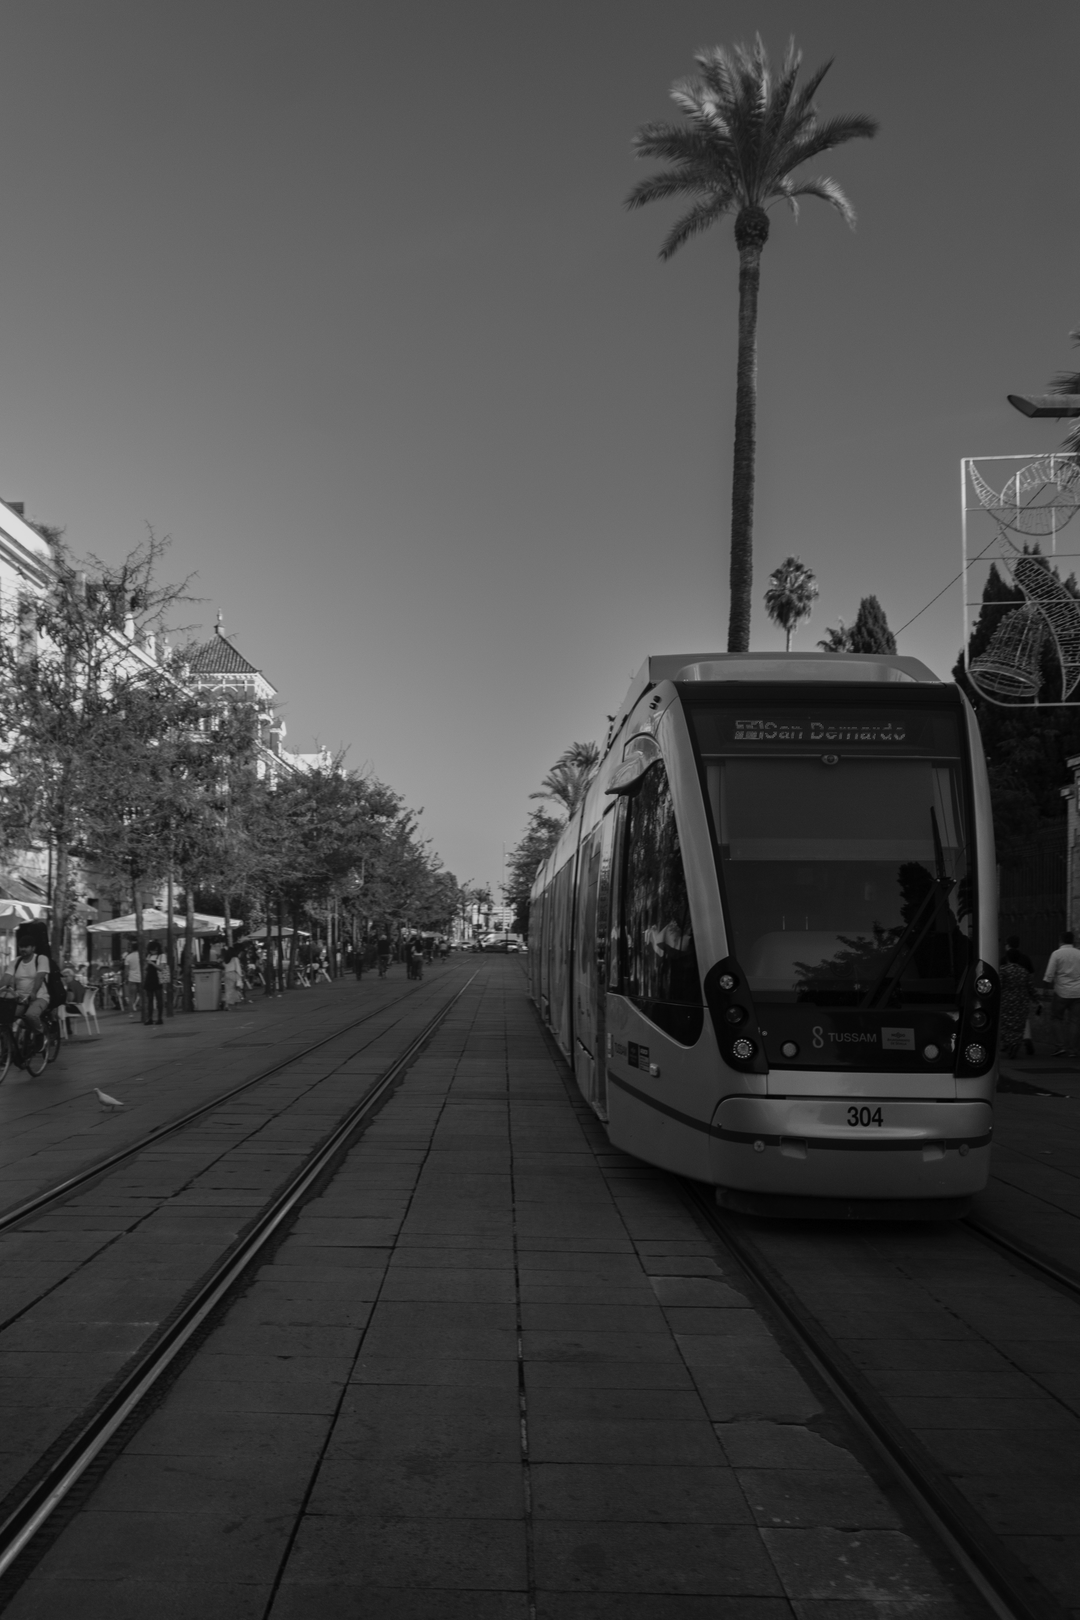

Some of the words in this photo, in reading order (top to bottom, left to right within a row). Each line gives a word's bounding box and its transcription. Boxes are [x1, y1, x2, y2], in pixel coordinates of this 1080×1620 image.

[765, 721, 803, 739] San
[828, 1032, 877, 1043] TUSSAM
[847, 1106, 884, 1127] 304
